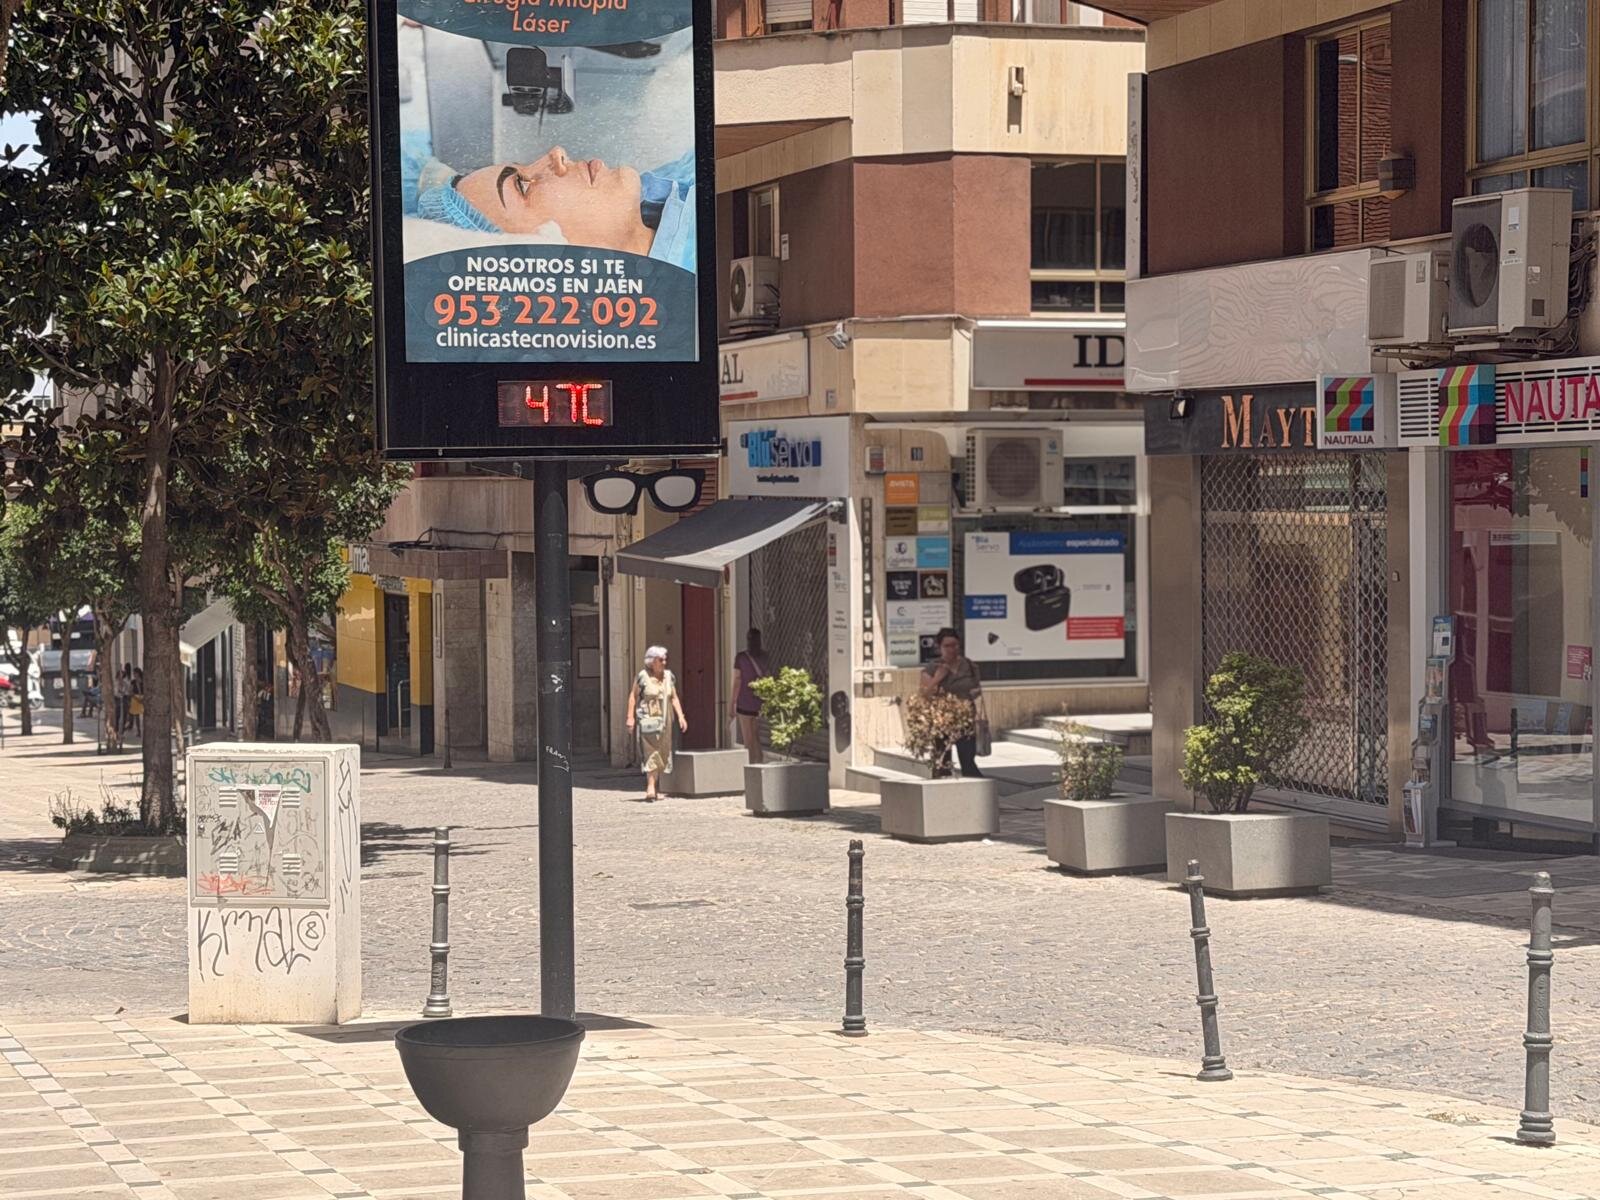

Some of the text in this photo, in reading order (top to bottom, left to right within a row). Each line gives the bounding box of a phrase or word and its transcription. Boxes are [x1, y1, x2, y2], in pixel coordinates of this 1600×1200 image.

[513, 10, 569, 32] Láser
[467, 256, 625, 276] NOSOTROS SI TE
[448, 275, 643, 294] OPERAMOS EN JAÉN
[433, 293, 659, 328] 953 222 092
[436, 327, 657, 349] clinicastecnovision.es
[1323, 434, 1375, 446] NAUTALIA
